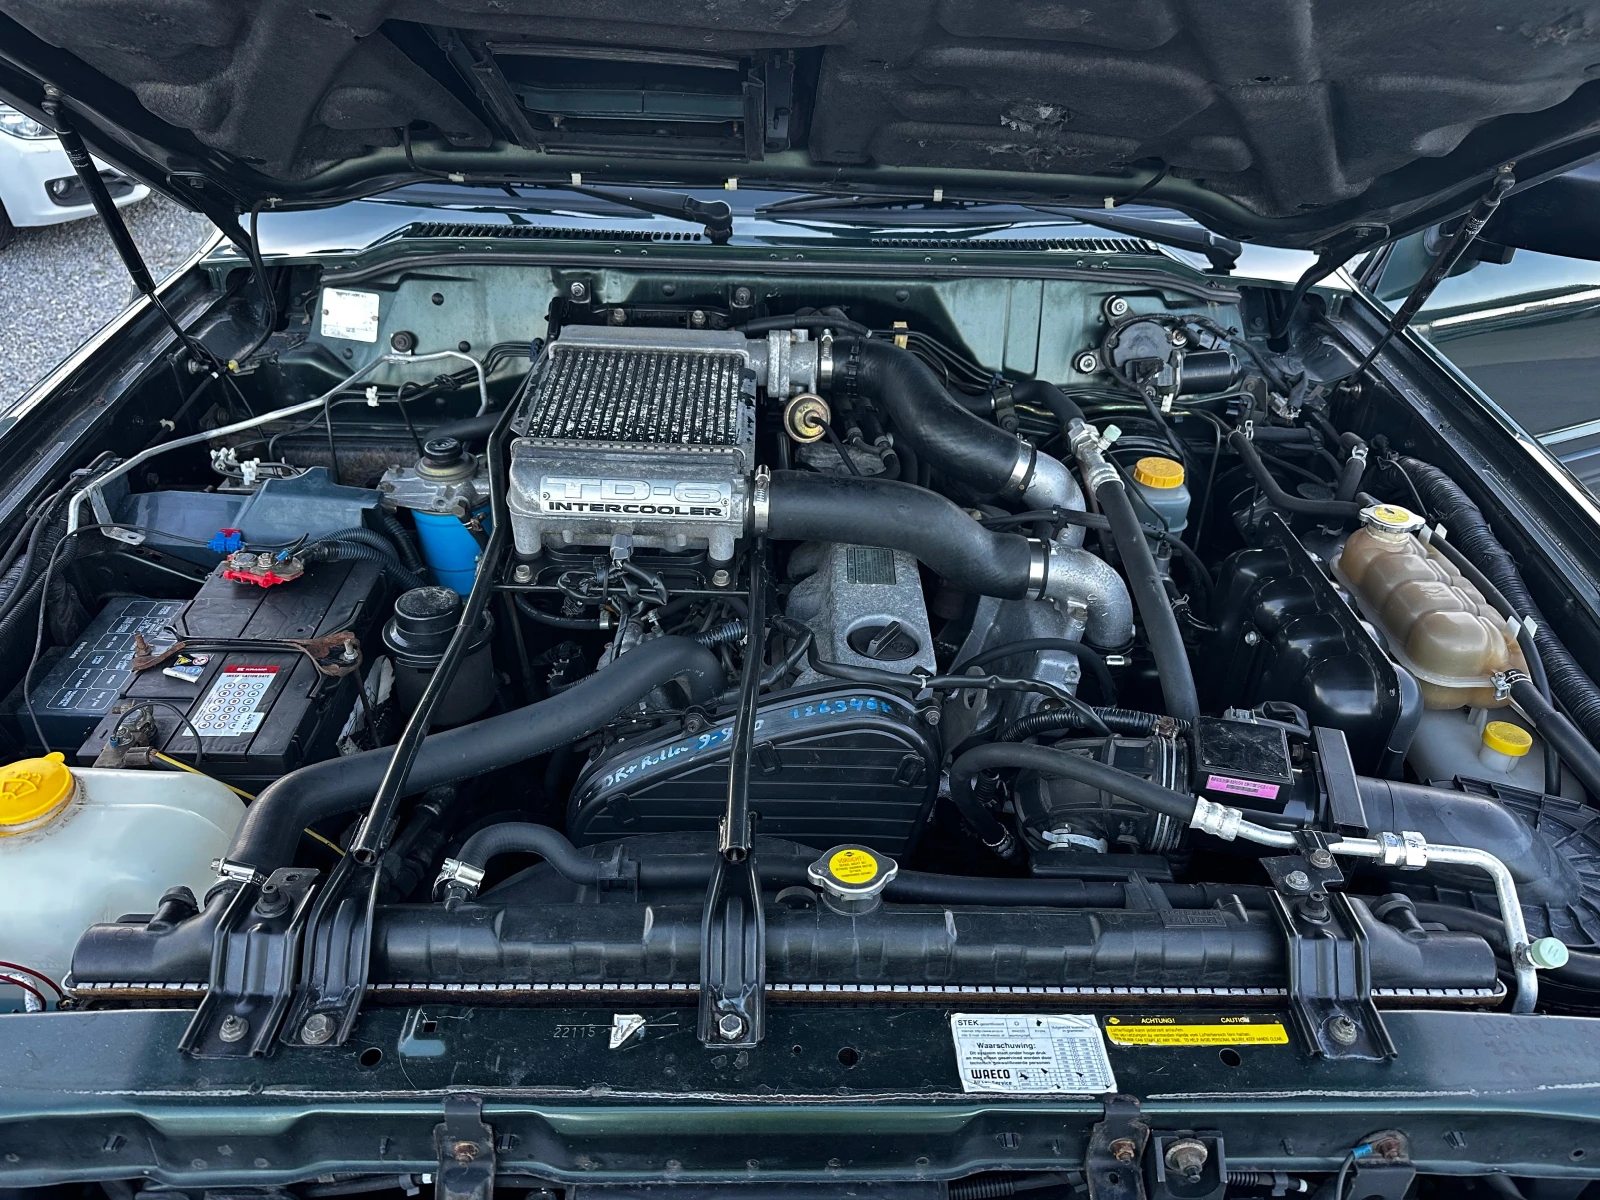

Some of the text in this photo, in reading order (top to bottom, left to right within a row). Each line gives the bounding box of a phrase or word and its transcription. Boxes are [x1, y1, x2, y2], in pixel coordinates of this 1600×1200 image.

[546, 478, 722, 504] TD-6
[548, 501, 722, 516] INTERCOOLER
[553, 1027, 596, 1038] 22115
[971, 1069, 1010, 1079] WAECO
